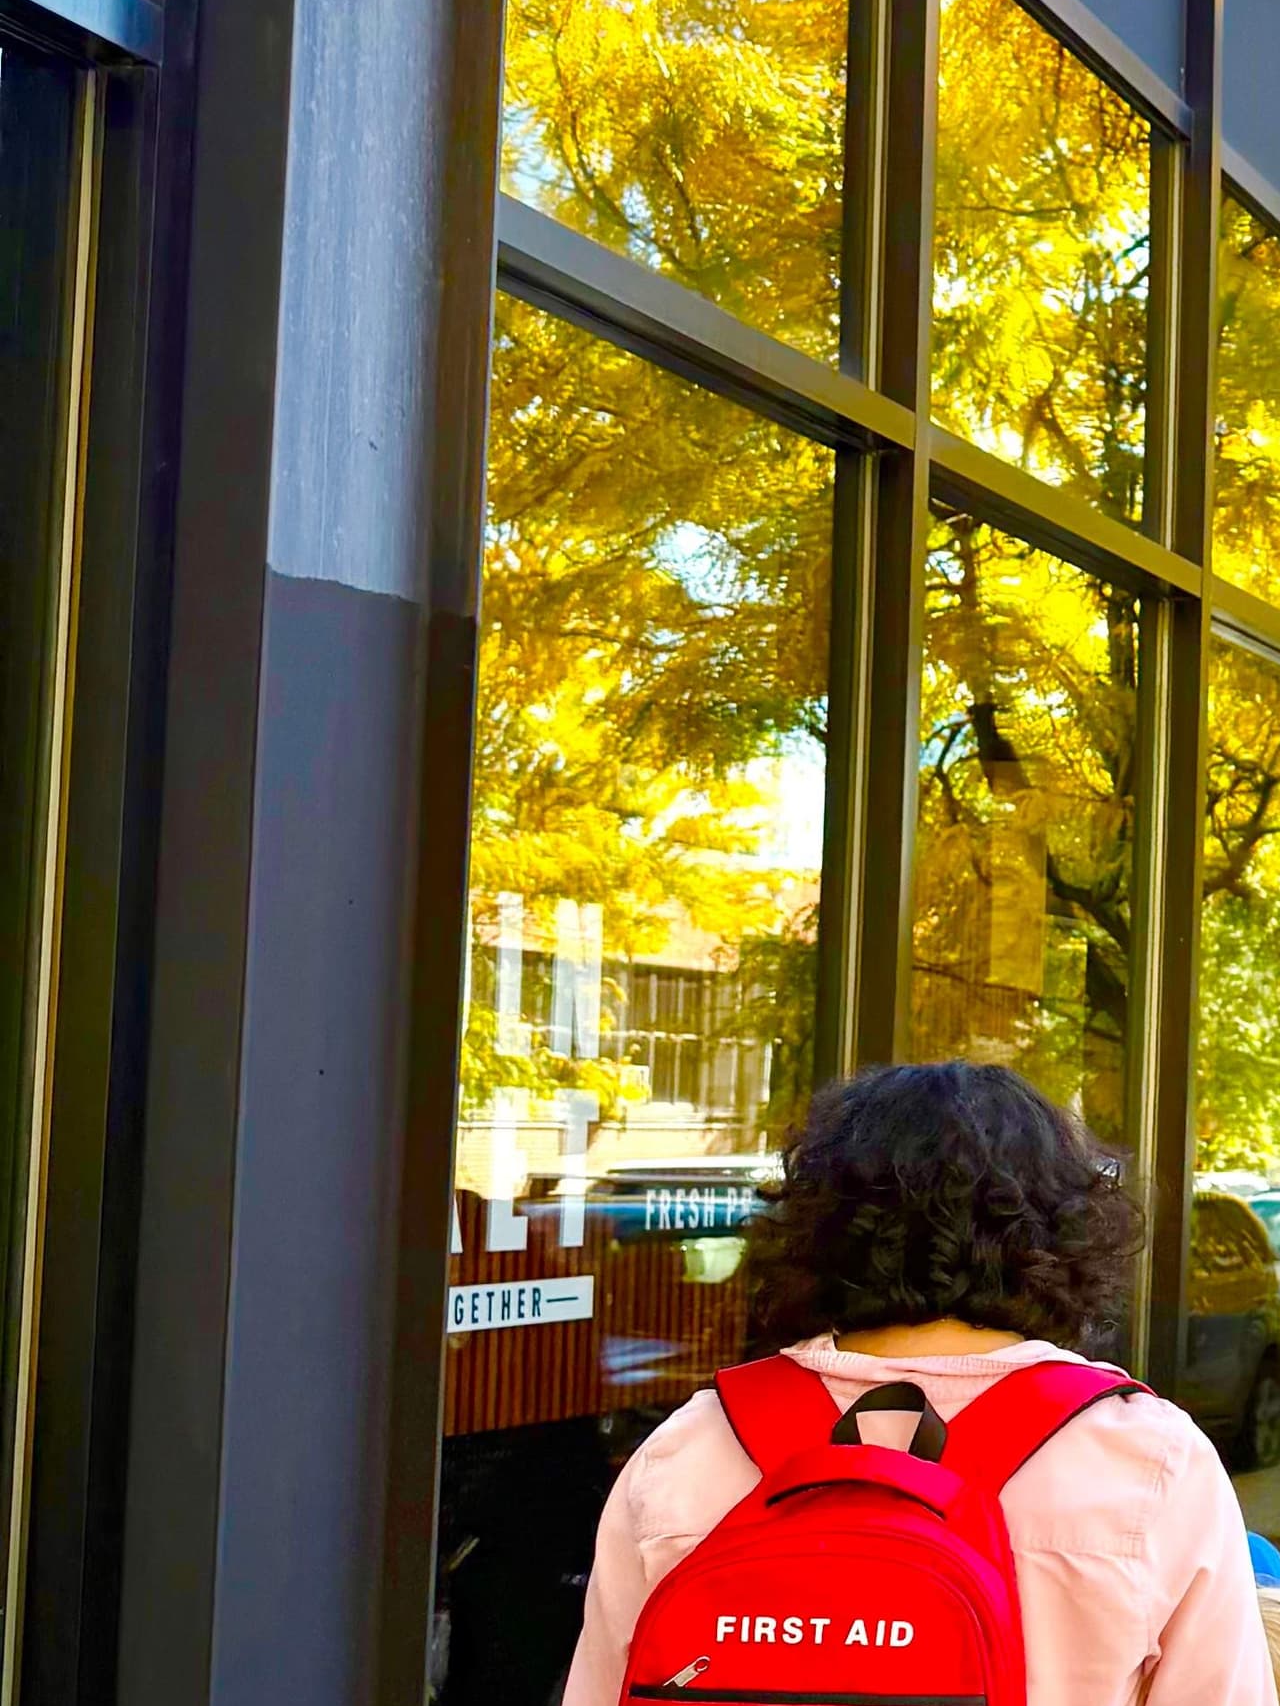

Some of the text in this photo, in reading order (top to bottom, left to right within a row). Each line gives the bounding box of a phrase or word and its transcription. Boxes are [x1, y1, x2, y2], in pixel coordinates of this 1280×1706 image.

[645, 1186, 715, 1231] FRESH
[716, 1616, 915, 1647] FIRST AID
